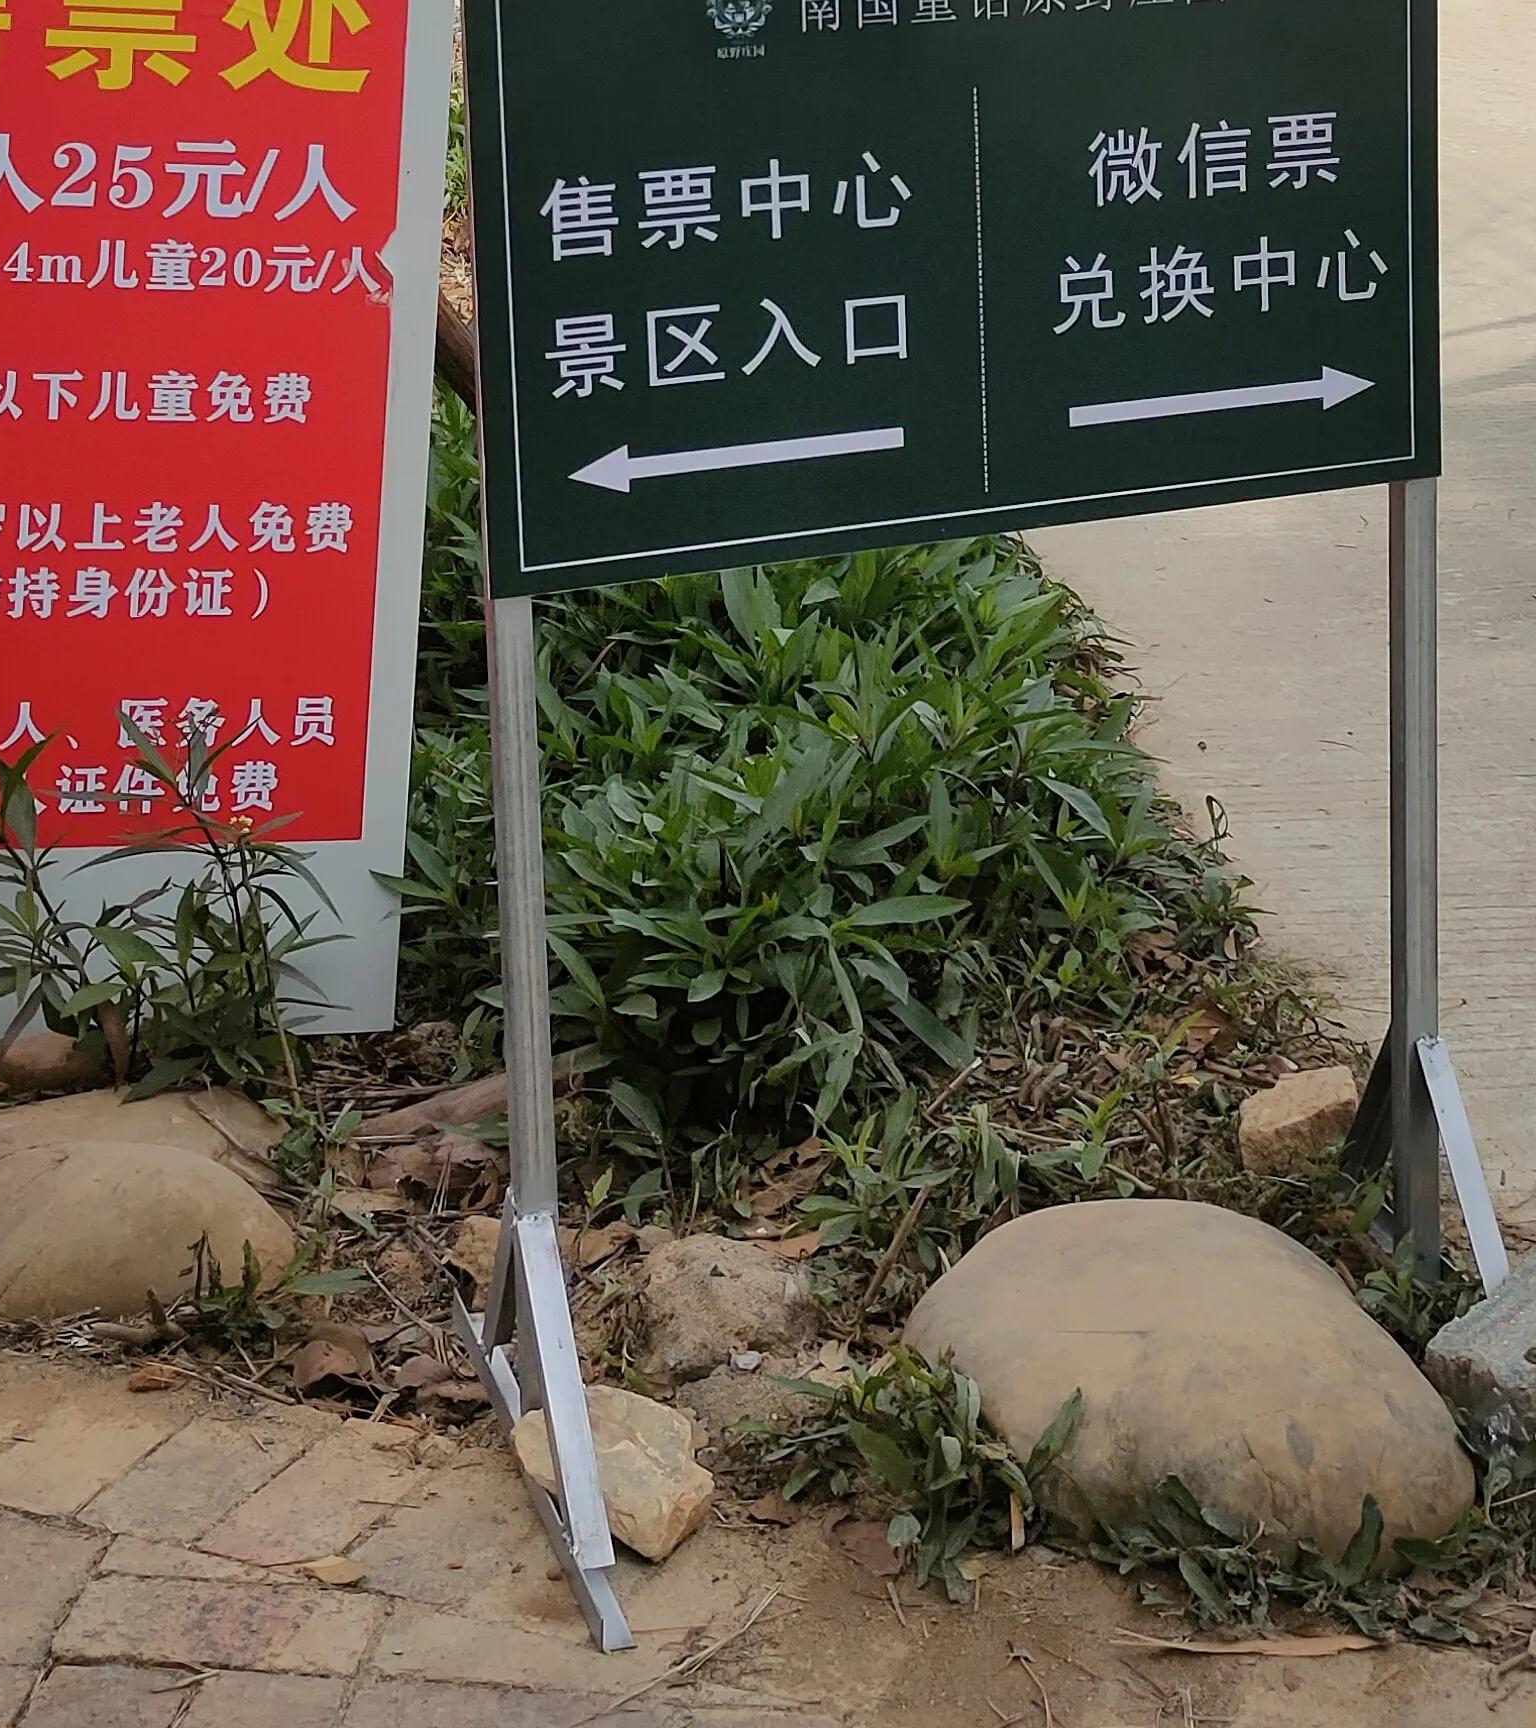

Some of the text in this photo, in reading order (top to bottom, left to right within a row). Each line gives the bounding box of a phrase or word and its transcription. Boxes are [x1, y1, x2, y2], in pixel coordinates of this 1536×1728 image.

[539, 151, 912, 262] 售票中心
[1088, 111, 1341, 207] 微信票
[1052, 228, 1388, 335] 兑换中心
[544, 294, 908, 399] 景区入口
